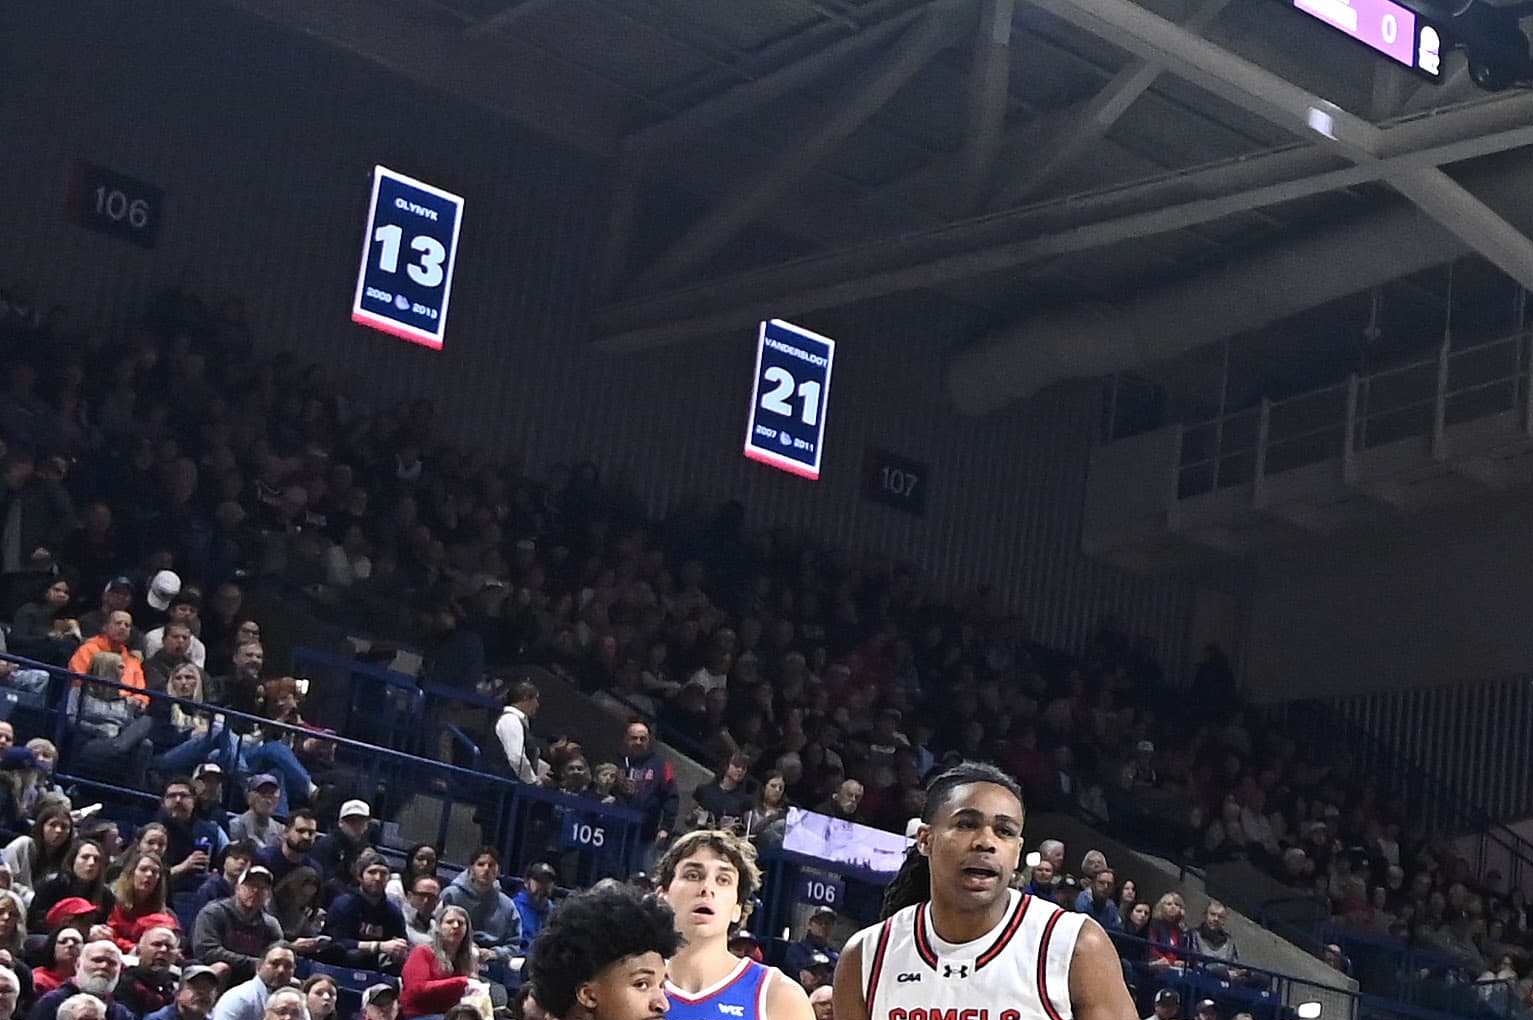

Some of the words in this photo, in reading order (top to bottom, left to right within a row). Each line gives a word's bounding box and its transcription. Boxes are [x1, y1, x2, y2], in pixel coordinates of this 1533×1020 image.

[96, 186, 150, 228] 106
[394, 198, 438, 221] OLYNYK
[375, 224, 446, 287] 13
[764, 336, 829, 369] VANDERSLOOT
[760, 366, 821, 427] 21
[882, 465, 918, 497] 107
[572, 822, 605, 848] 105
[807, 880, 836, 903] 106
